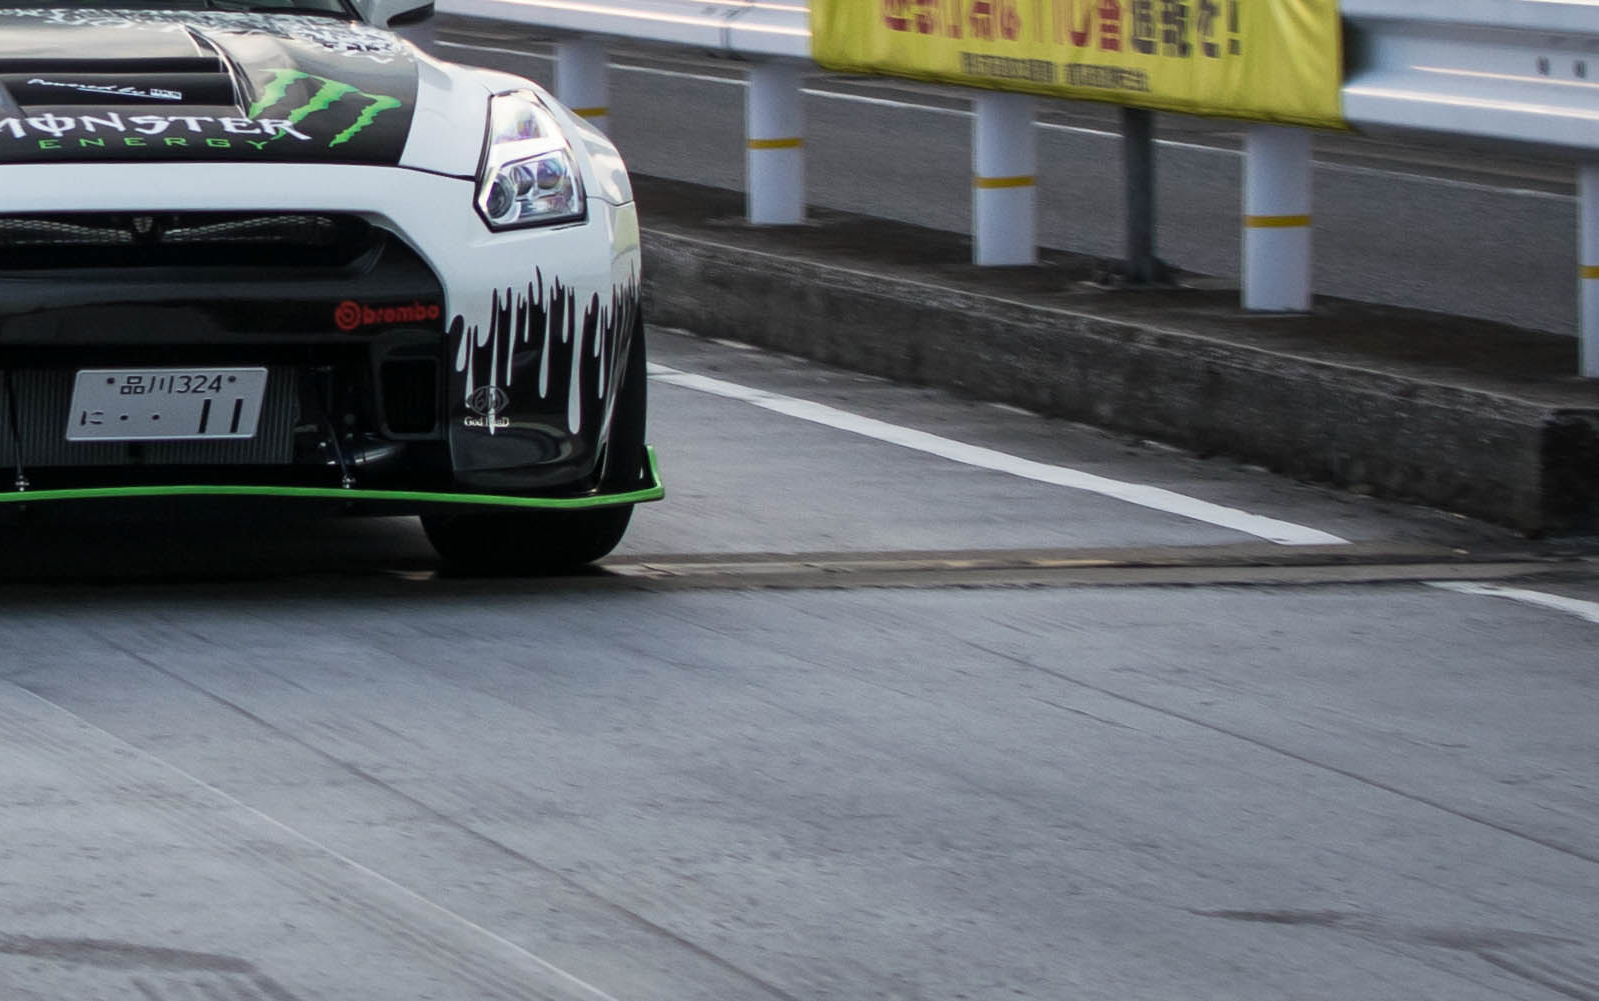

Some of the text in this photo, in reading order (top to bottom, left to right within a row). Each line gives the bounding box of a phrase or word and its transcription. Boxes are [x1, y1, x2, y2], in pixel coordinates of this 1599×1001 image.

[39, 137, 269, 150] ENERGY
[363, 302, 441, 325] brembo
[79, 410, 104, 427] に
